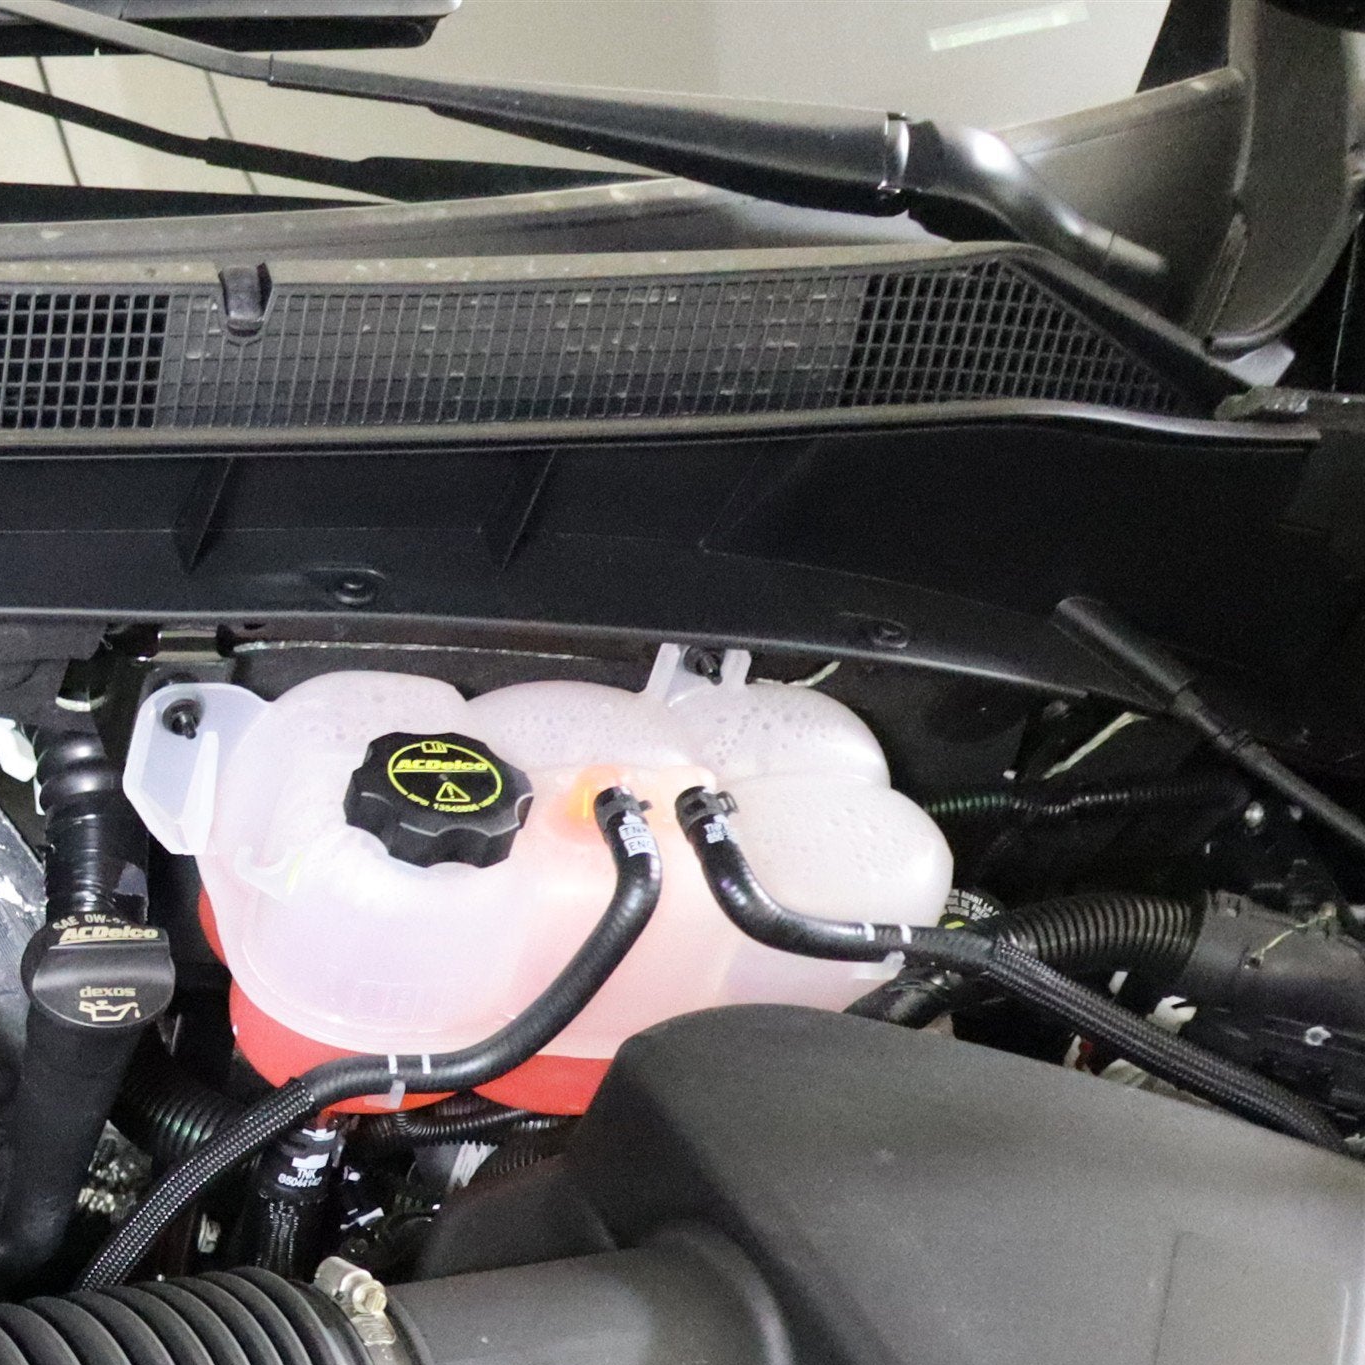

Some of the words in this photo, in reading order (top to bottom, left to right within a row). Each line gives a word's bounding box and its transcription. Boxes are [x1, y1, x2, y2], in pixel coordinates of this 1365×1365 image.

[395, 759, 488, 771] ACDelco
[52, 915, 79, 930] SAE
[59, 925, 159, 942] ACDelco
[79, 986, 137, 998] dexos
